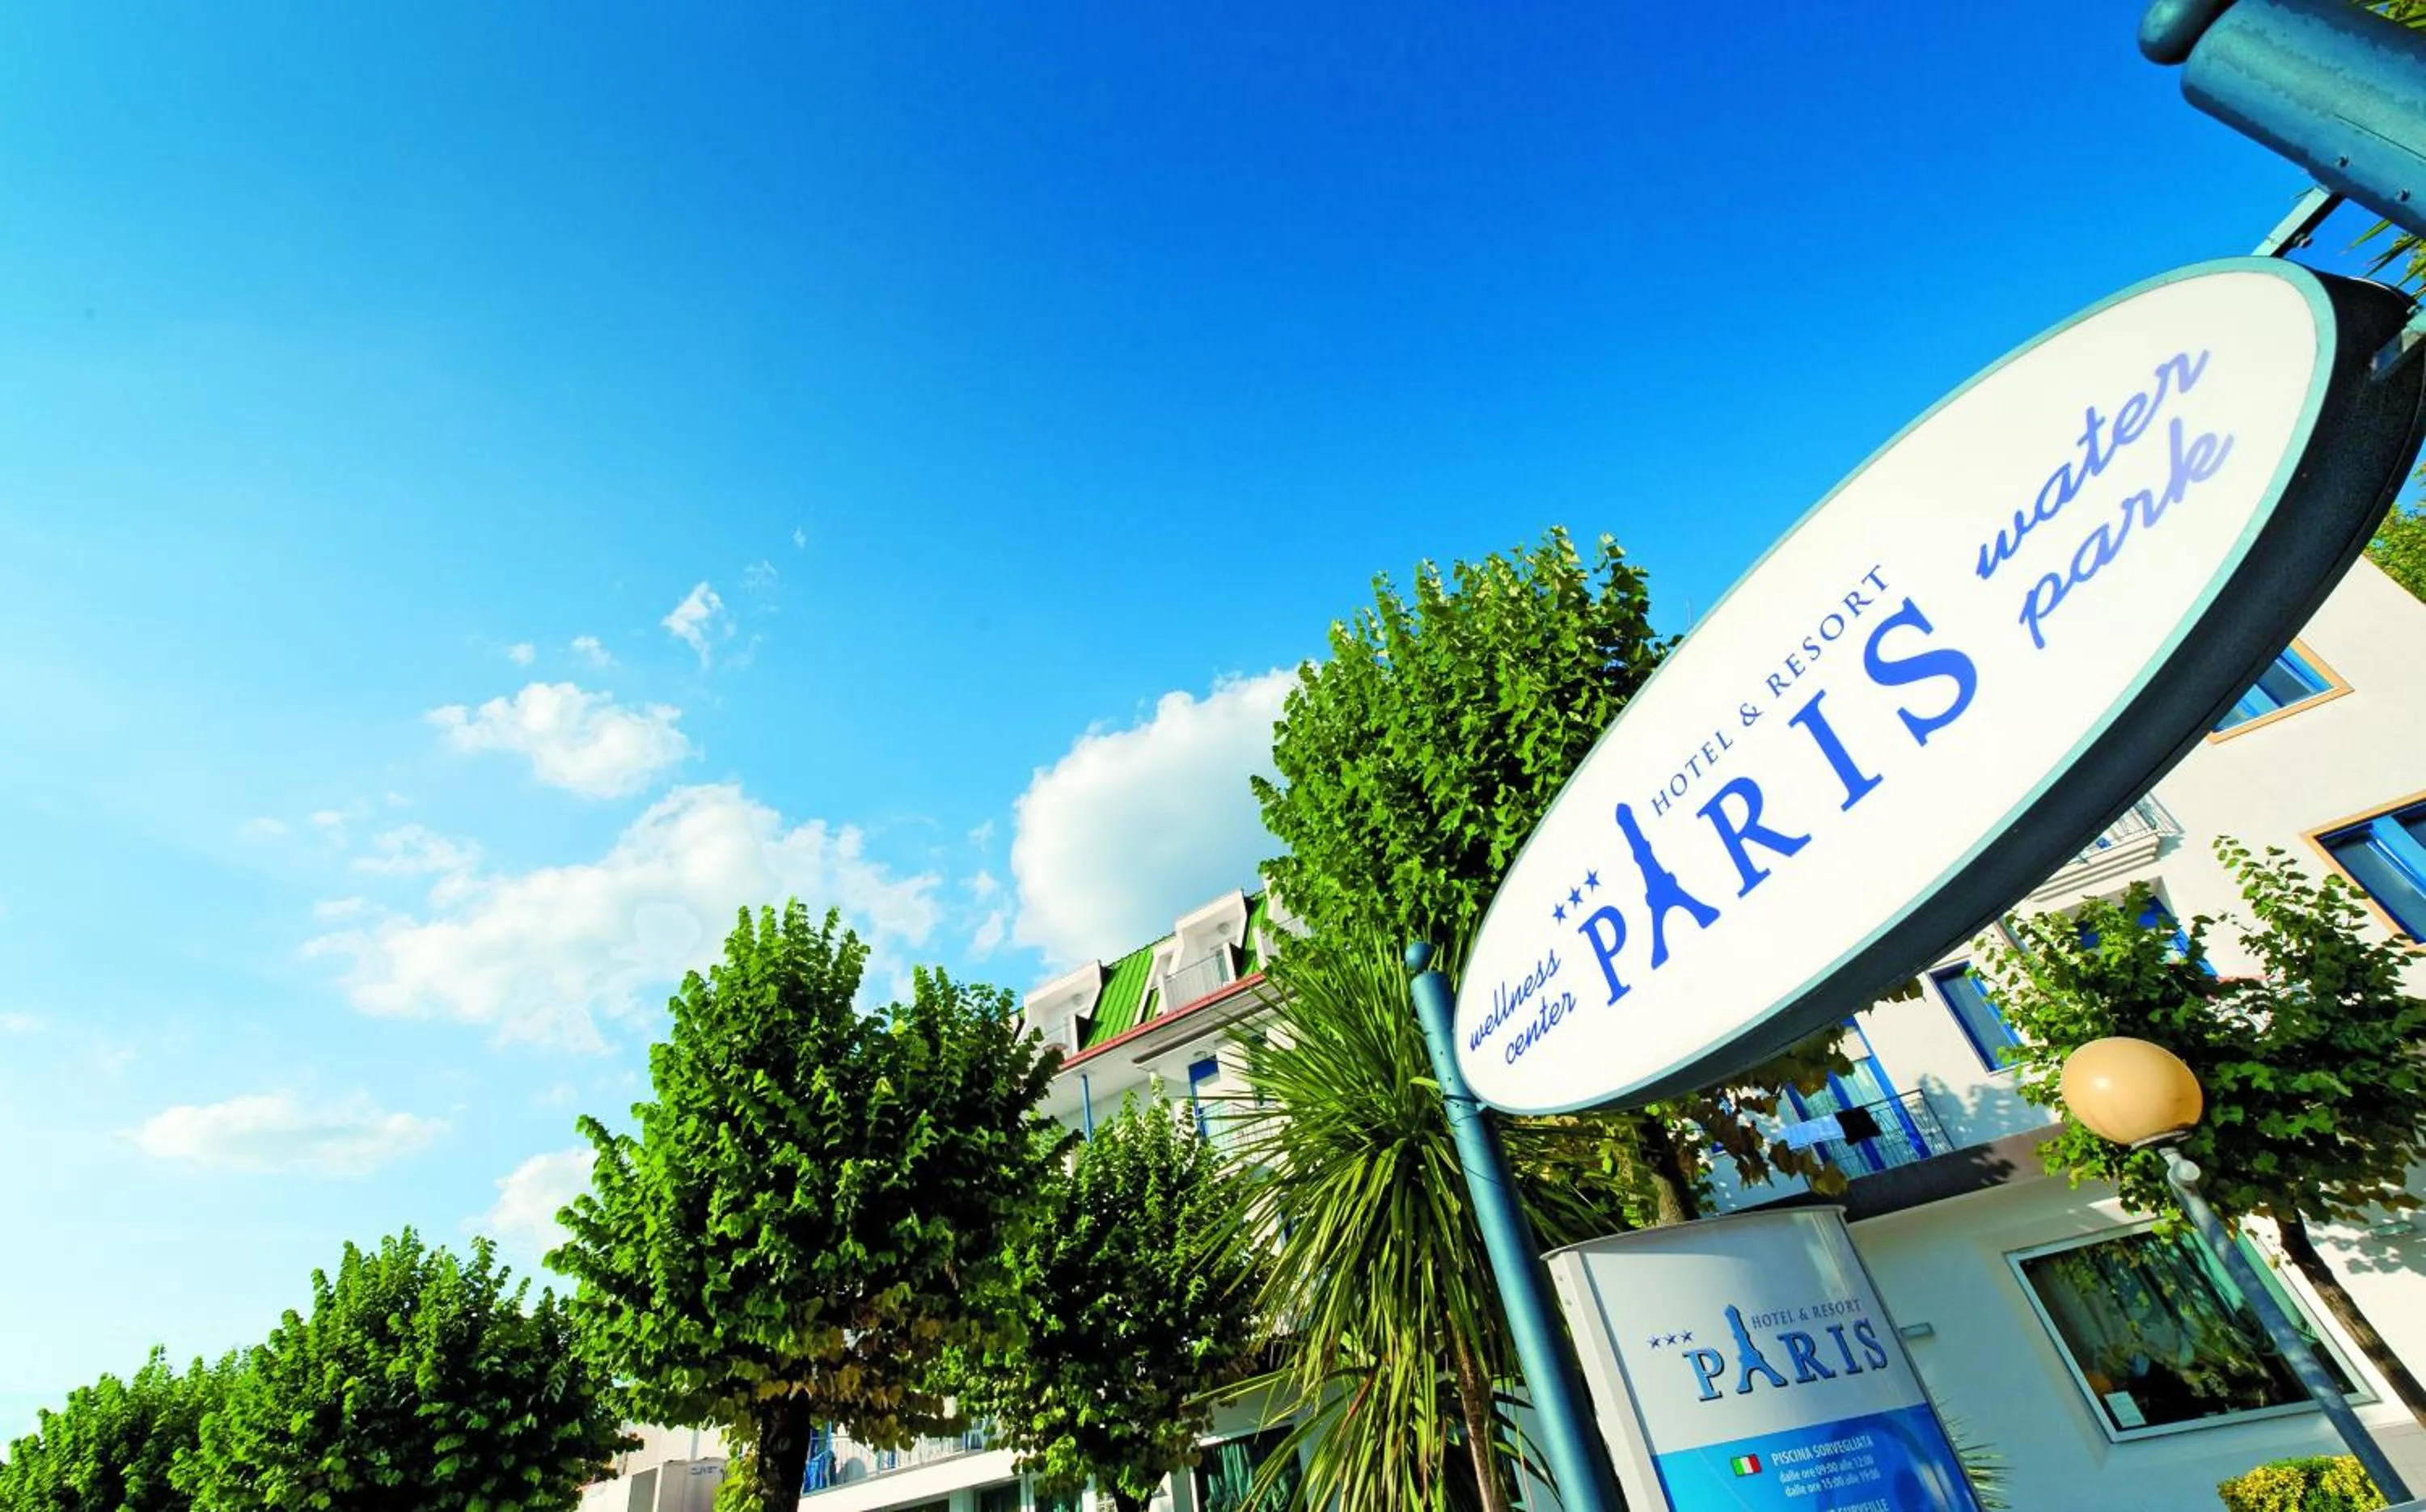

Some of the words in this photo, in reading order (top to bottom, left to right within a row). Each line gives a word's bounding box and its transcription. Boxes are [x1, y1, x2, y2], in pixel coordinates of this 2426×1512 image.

[1976, 349, 2209, 580] water
[2019, 417, 2234, 649] park
[1650, 731, 1734, 817] HOTEL
[1739, 703, 1765, 727] &
[1765, 564, 1889, 698] RESORT
[1578, 597, 1978, 1007] PARIS
[1469, 948, 1562, 1051] wellness
[1505, 991, 1577, 1065] center
[1682, 1303, 1888, 1401] PARIS
[1752, 1309, 1794, 1329] HOTEL
[1798, 1307, 1810, 1320] &
[1812, 1298, 1862, 1319] RESORT
[1771, 1447, 1813, 1466] PISCINA
